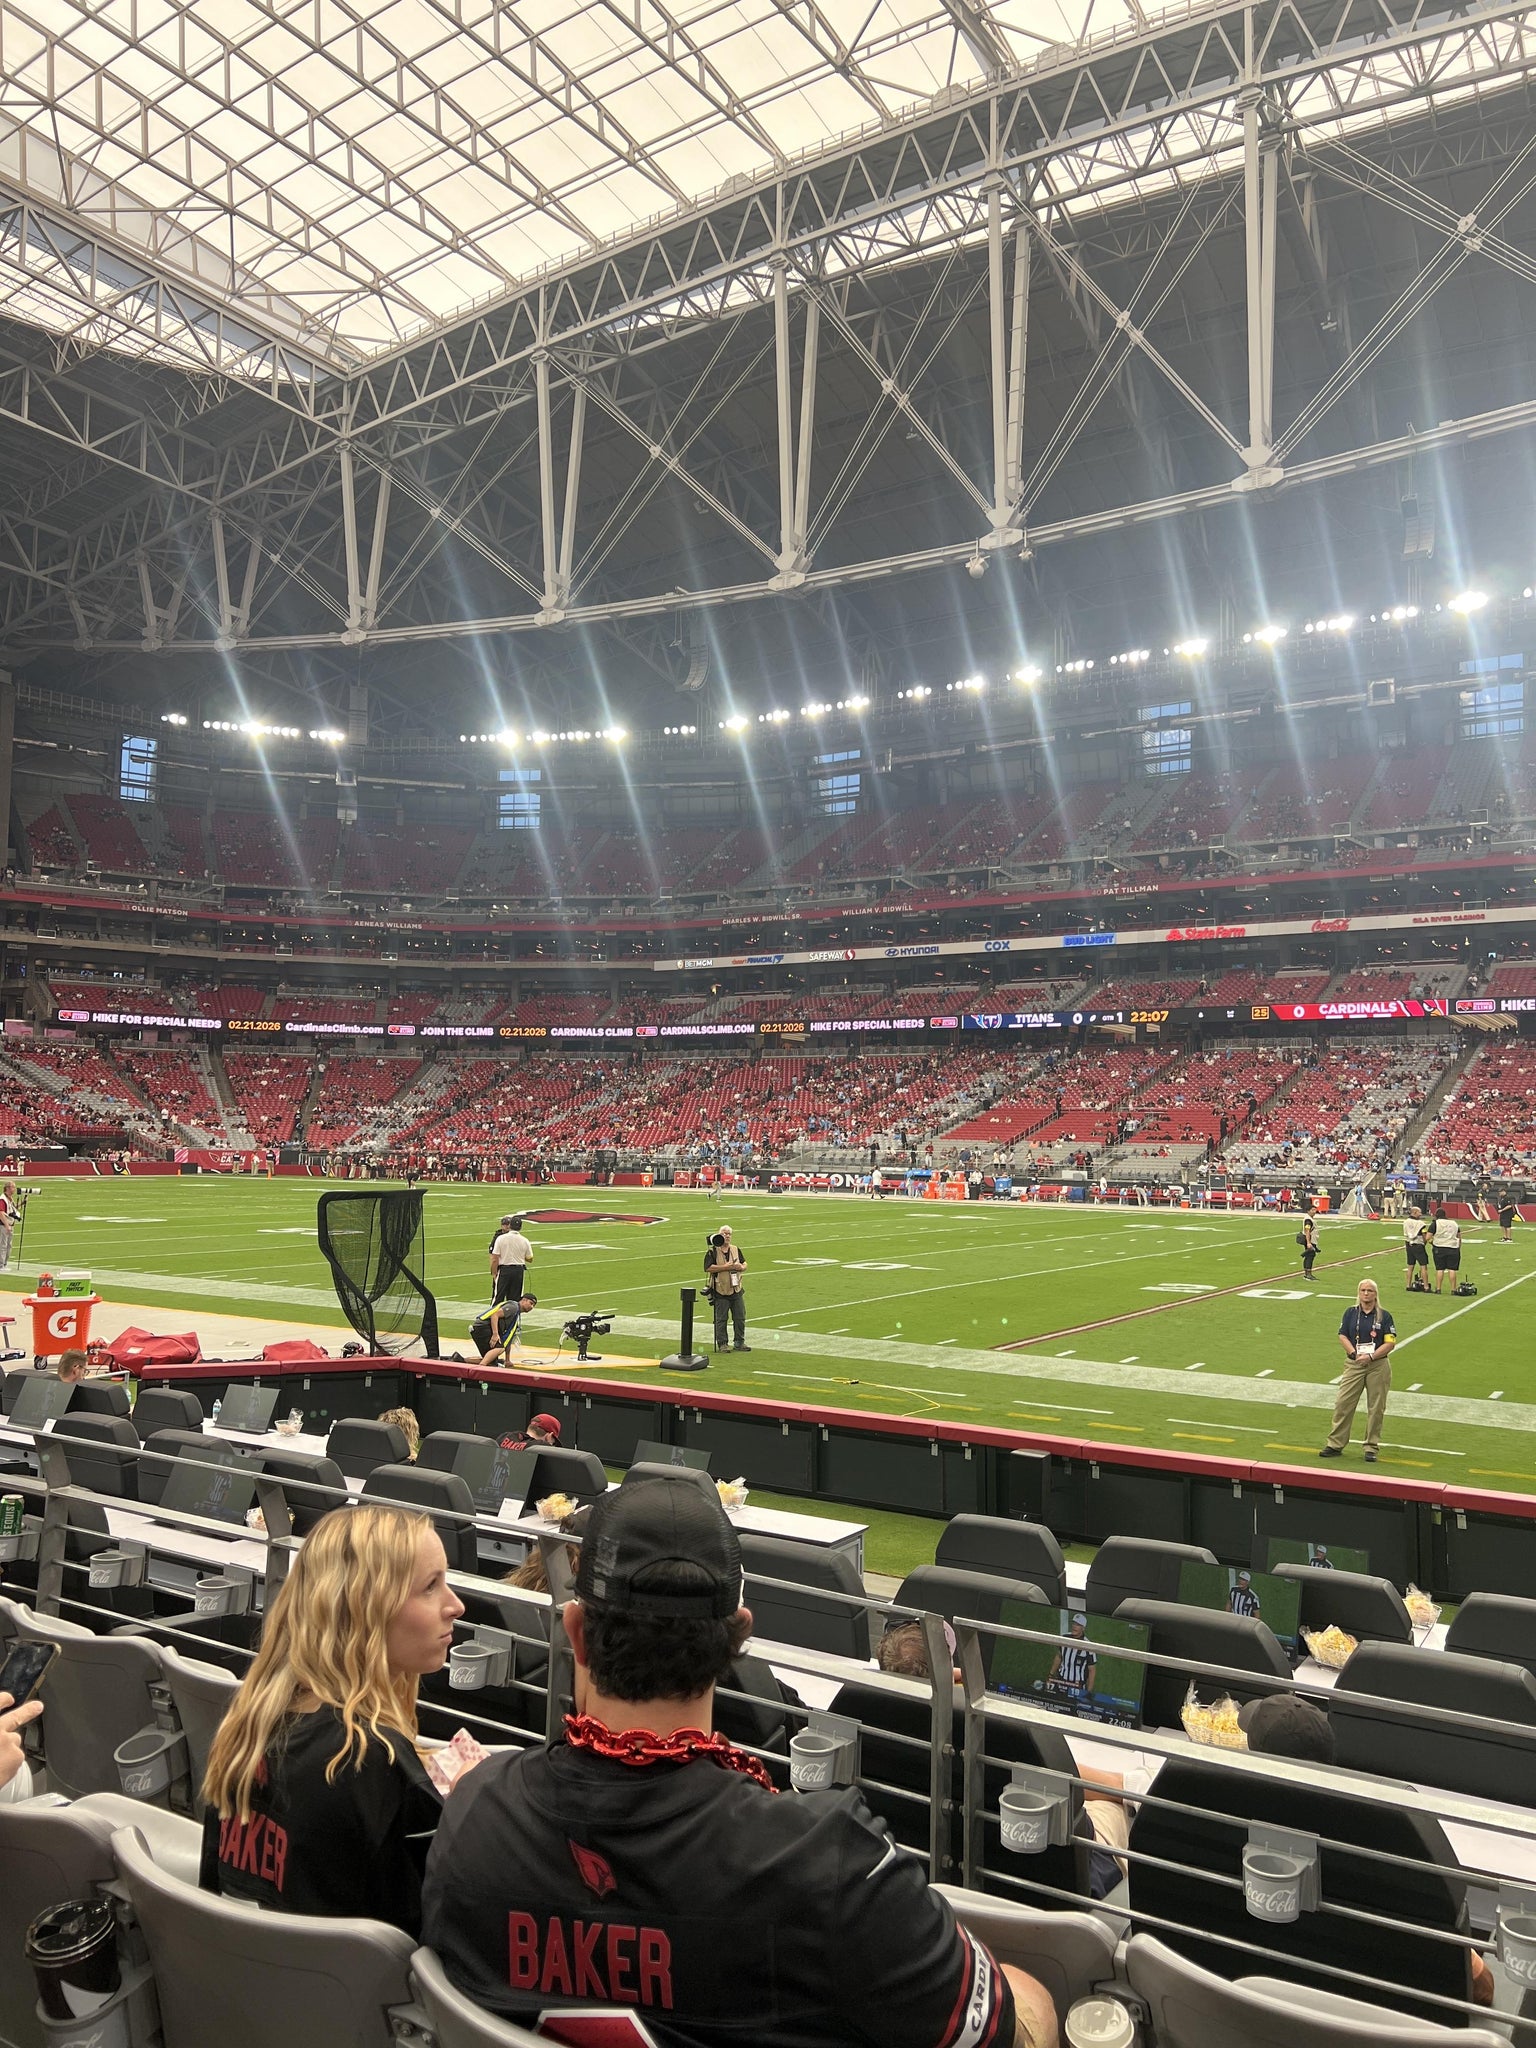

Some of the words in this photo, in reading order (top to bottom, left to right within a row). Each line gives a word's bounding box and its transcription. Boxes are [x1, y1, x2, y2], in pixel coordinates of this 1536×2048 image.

[1122, 884, 1159, 894] TILLMAN
[132, 905, 154, 913] OLLIE
[156, 908, 188, 916] MATSON
[842, 908, 872, 916] WILLIAM
[722, 917, 750, 925] CHARLES
[1185, 928, 1214, 940] State
[1216, 926, 1246, 938] Farm
[984, 940, 1010, 952] COX
[1065, 936, 1084, 946] BUD
[1086, 934, 1114, 944] LIGHT
[809, 952, 844, 961] SAFEWAY
[900, 946, 939, 956] HYUNDAI
[1319, 1002, 1398, 1016] CARDINALS
[1500, 999, 1536, 1011] HIKE
[1072, 1012, 1083, 1024] 0
[1116, 1012, 1123, 1023] 1
[1130, 1010, 1170, 1022] 22:07
[1254, 1008, 1268, 1018] 25
[1294, 1006, 1305, 1018] 0
[92, 1013, 118, 1024] HIKE
[120, 1015, 142, 1025] FOR
[142, 1016, 187, 1027] SPECIAL
[188, 1018, 222, 1029] NEEDS
[810, 1022, 832, 1032] HIKE
[832, 1021, 852, 1030] FOR
[852, 1020, 892, 1030] SPECIAL
[893, 1018, 925, 1028] NEEDS
[1014, 1014, 1054, 1024] TITANS
[228, 1020, 281, 1031] 02.21.2026
[286, 1022, 384, 1034] CardinalsClimb.com
[420, 1027, 446, 1036] JOIN
[446, 1028, 466, 1036] THE
[466, 1028, 494, 1036] CLIMB
[660, 1024, 755, 1036] CARDINALSCLIMB.COM
[760, 1022, 804, 1033] 02.21.2026
[500, 1028, 546, 1036] 02.21.2026
[551, 1028, 604, 1037] CARDINALS
[605, 1028, 634, 1036] CLIMB
[48, 1309, 78, 1338] G
[500, 1438, 527, 1450] BAKER
[4, 1506, 15, 1530] EQUIS
[1108, 1718, 1132, 1729] 22:08
[219, 1810, 288, 1893] BAKER
[509, 1910, 673, 2009] BAKER
[972, 1958, 987, 2032] CARDI
